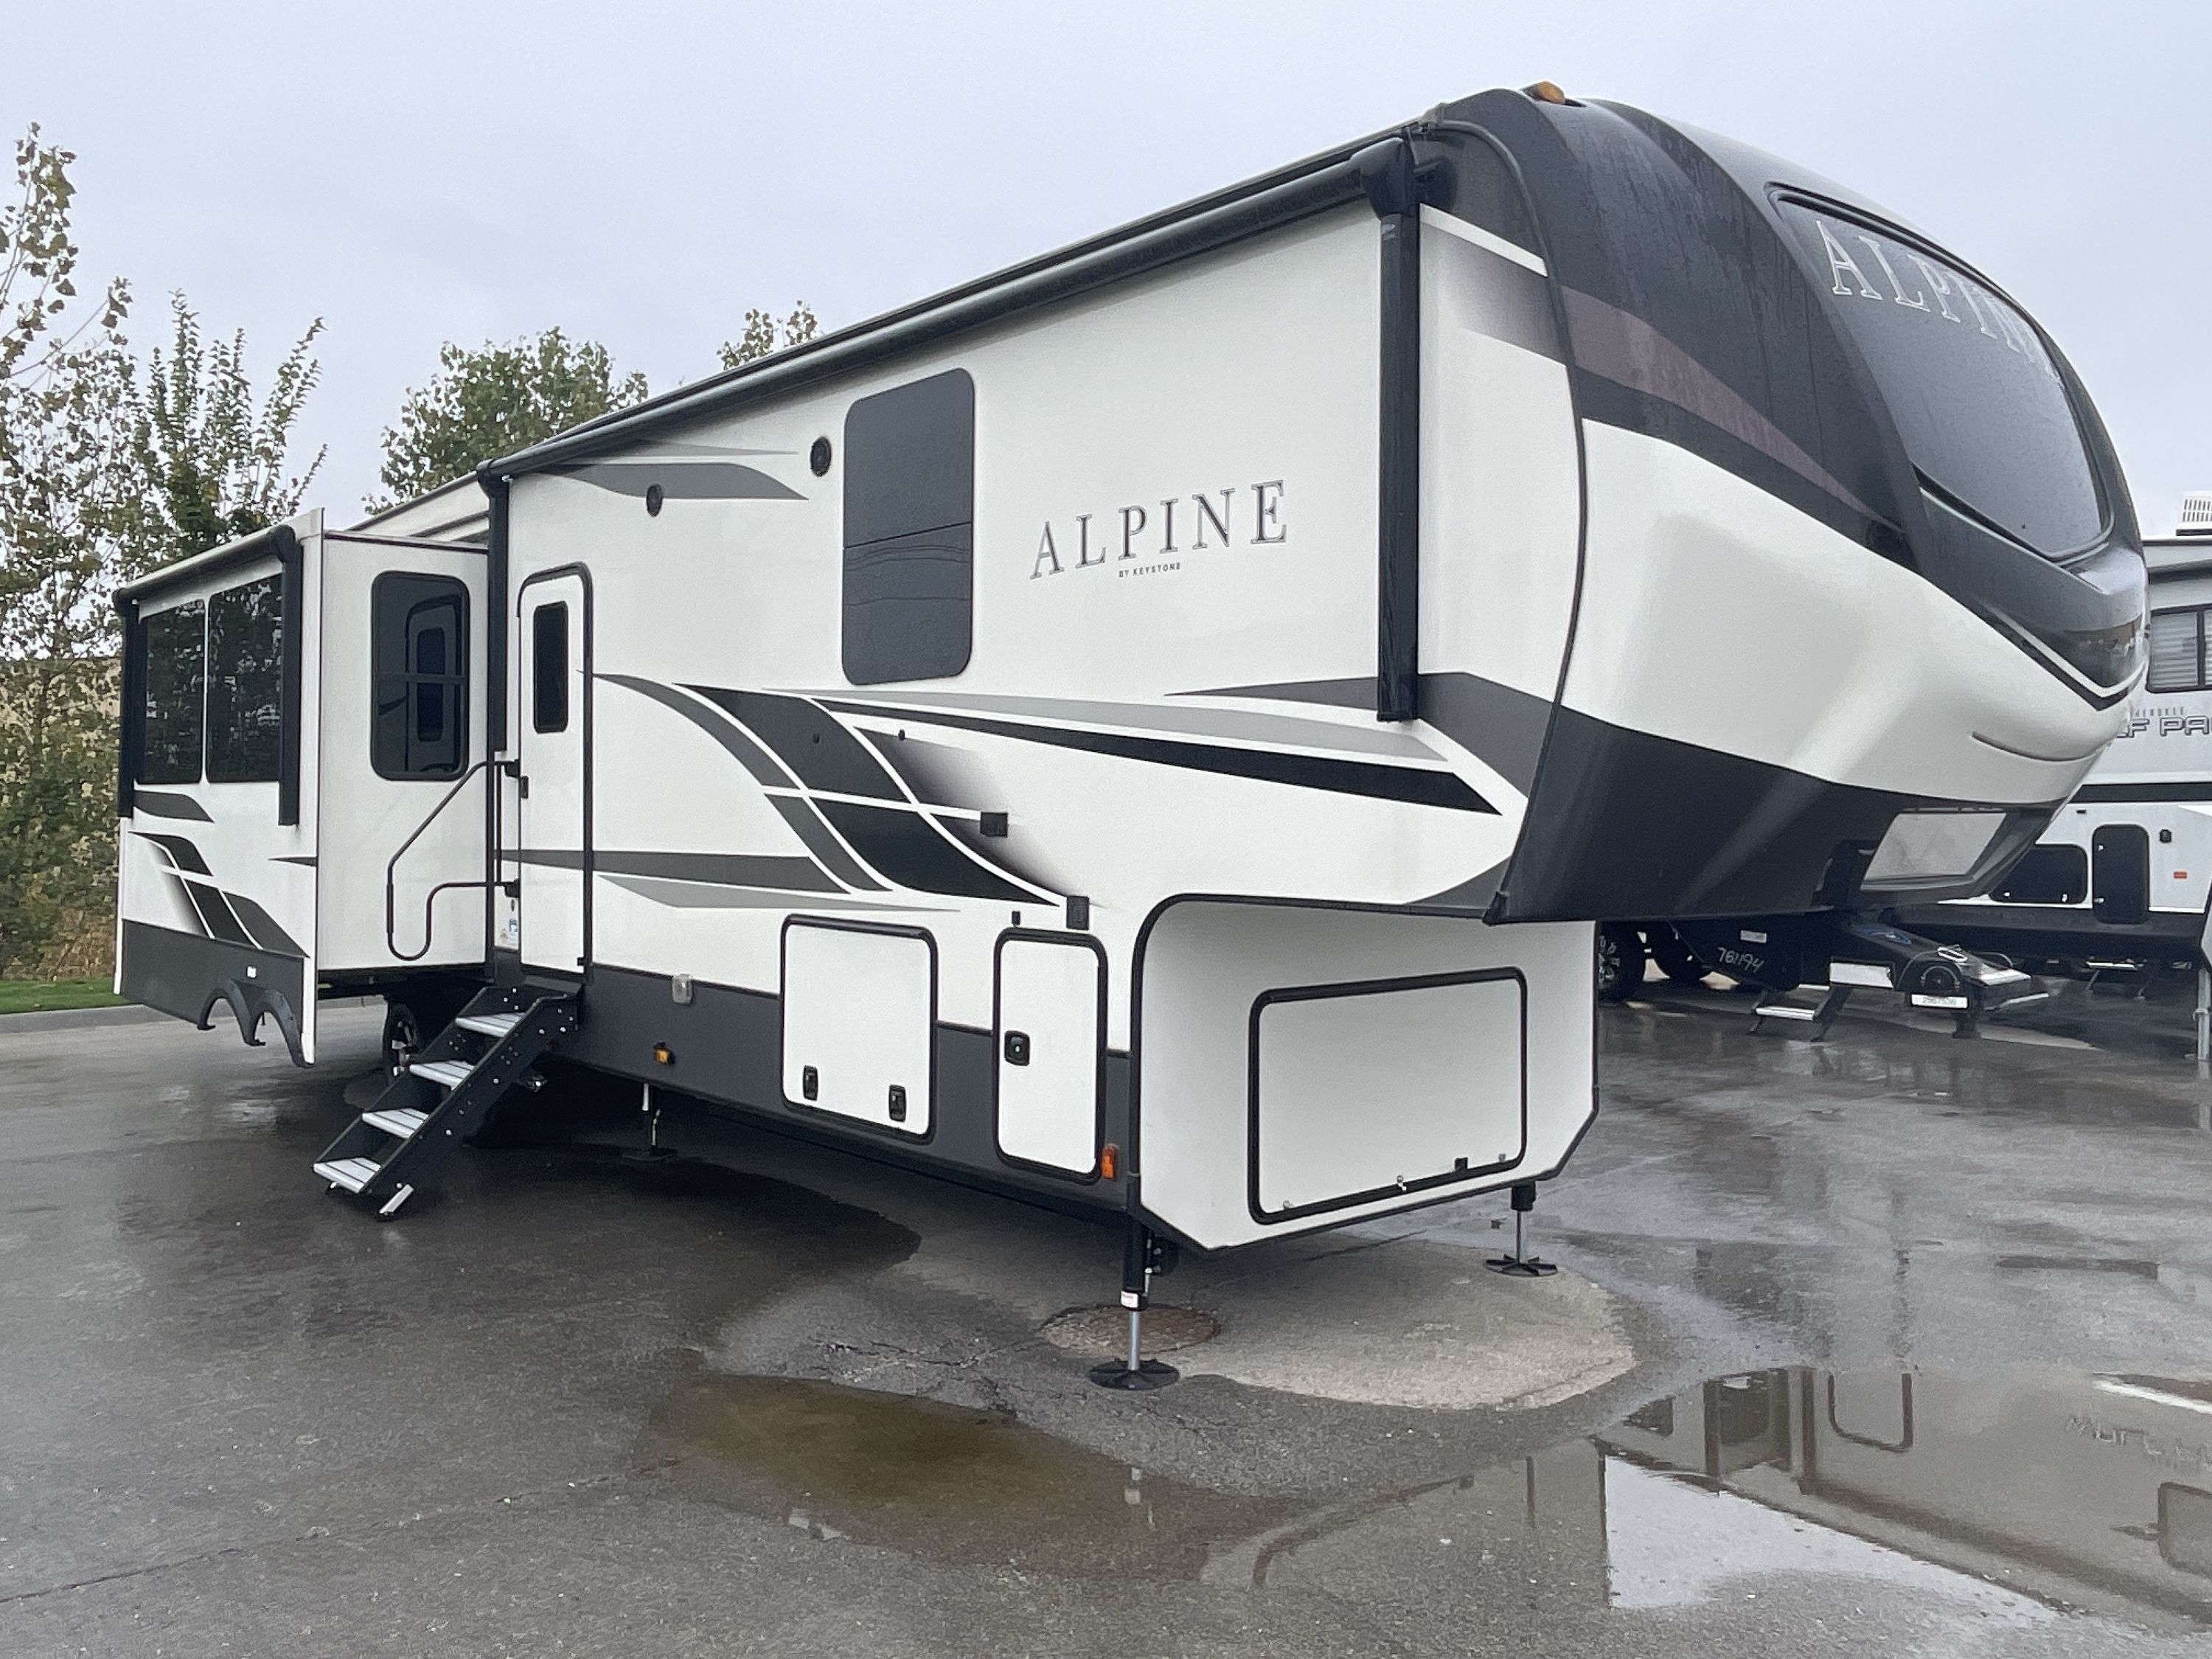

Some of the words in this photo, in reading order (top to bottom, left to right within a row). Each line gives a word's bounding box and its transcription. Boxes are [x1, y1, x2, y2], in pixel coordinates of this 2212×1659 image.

[1816, 220, 2052, 373] ALPIN
[1030, 479, 1287, 580] ALPINE
[1119, 569, 1129, 578] BY
[1133, 562, 1181, 575] KEYSTONE
[2159, 715, 2212, 737] PA
